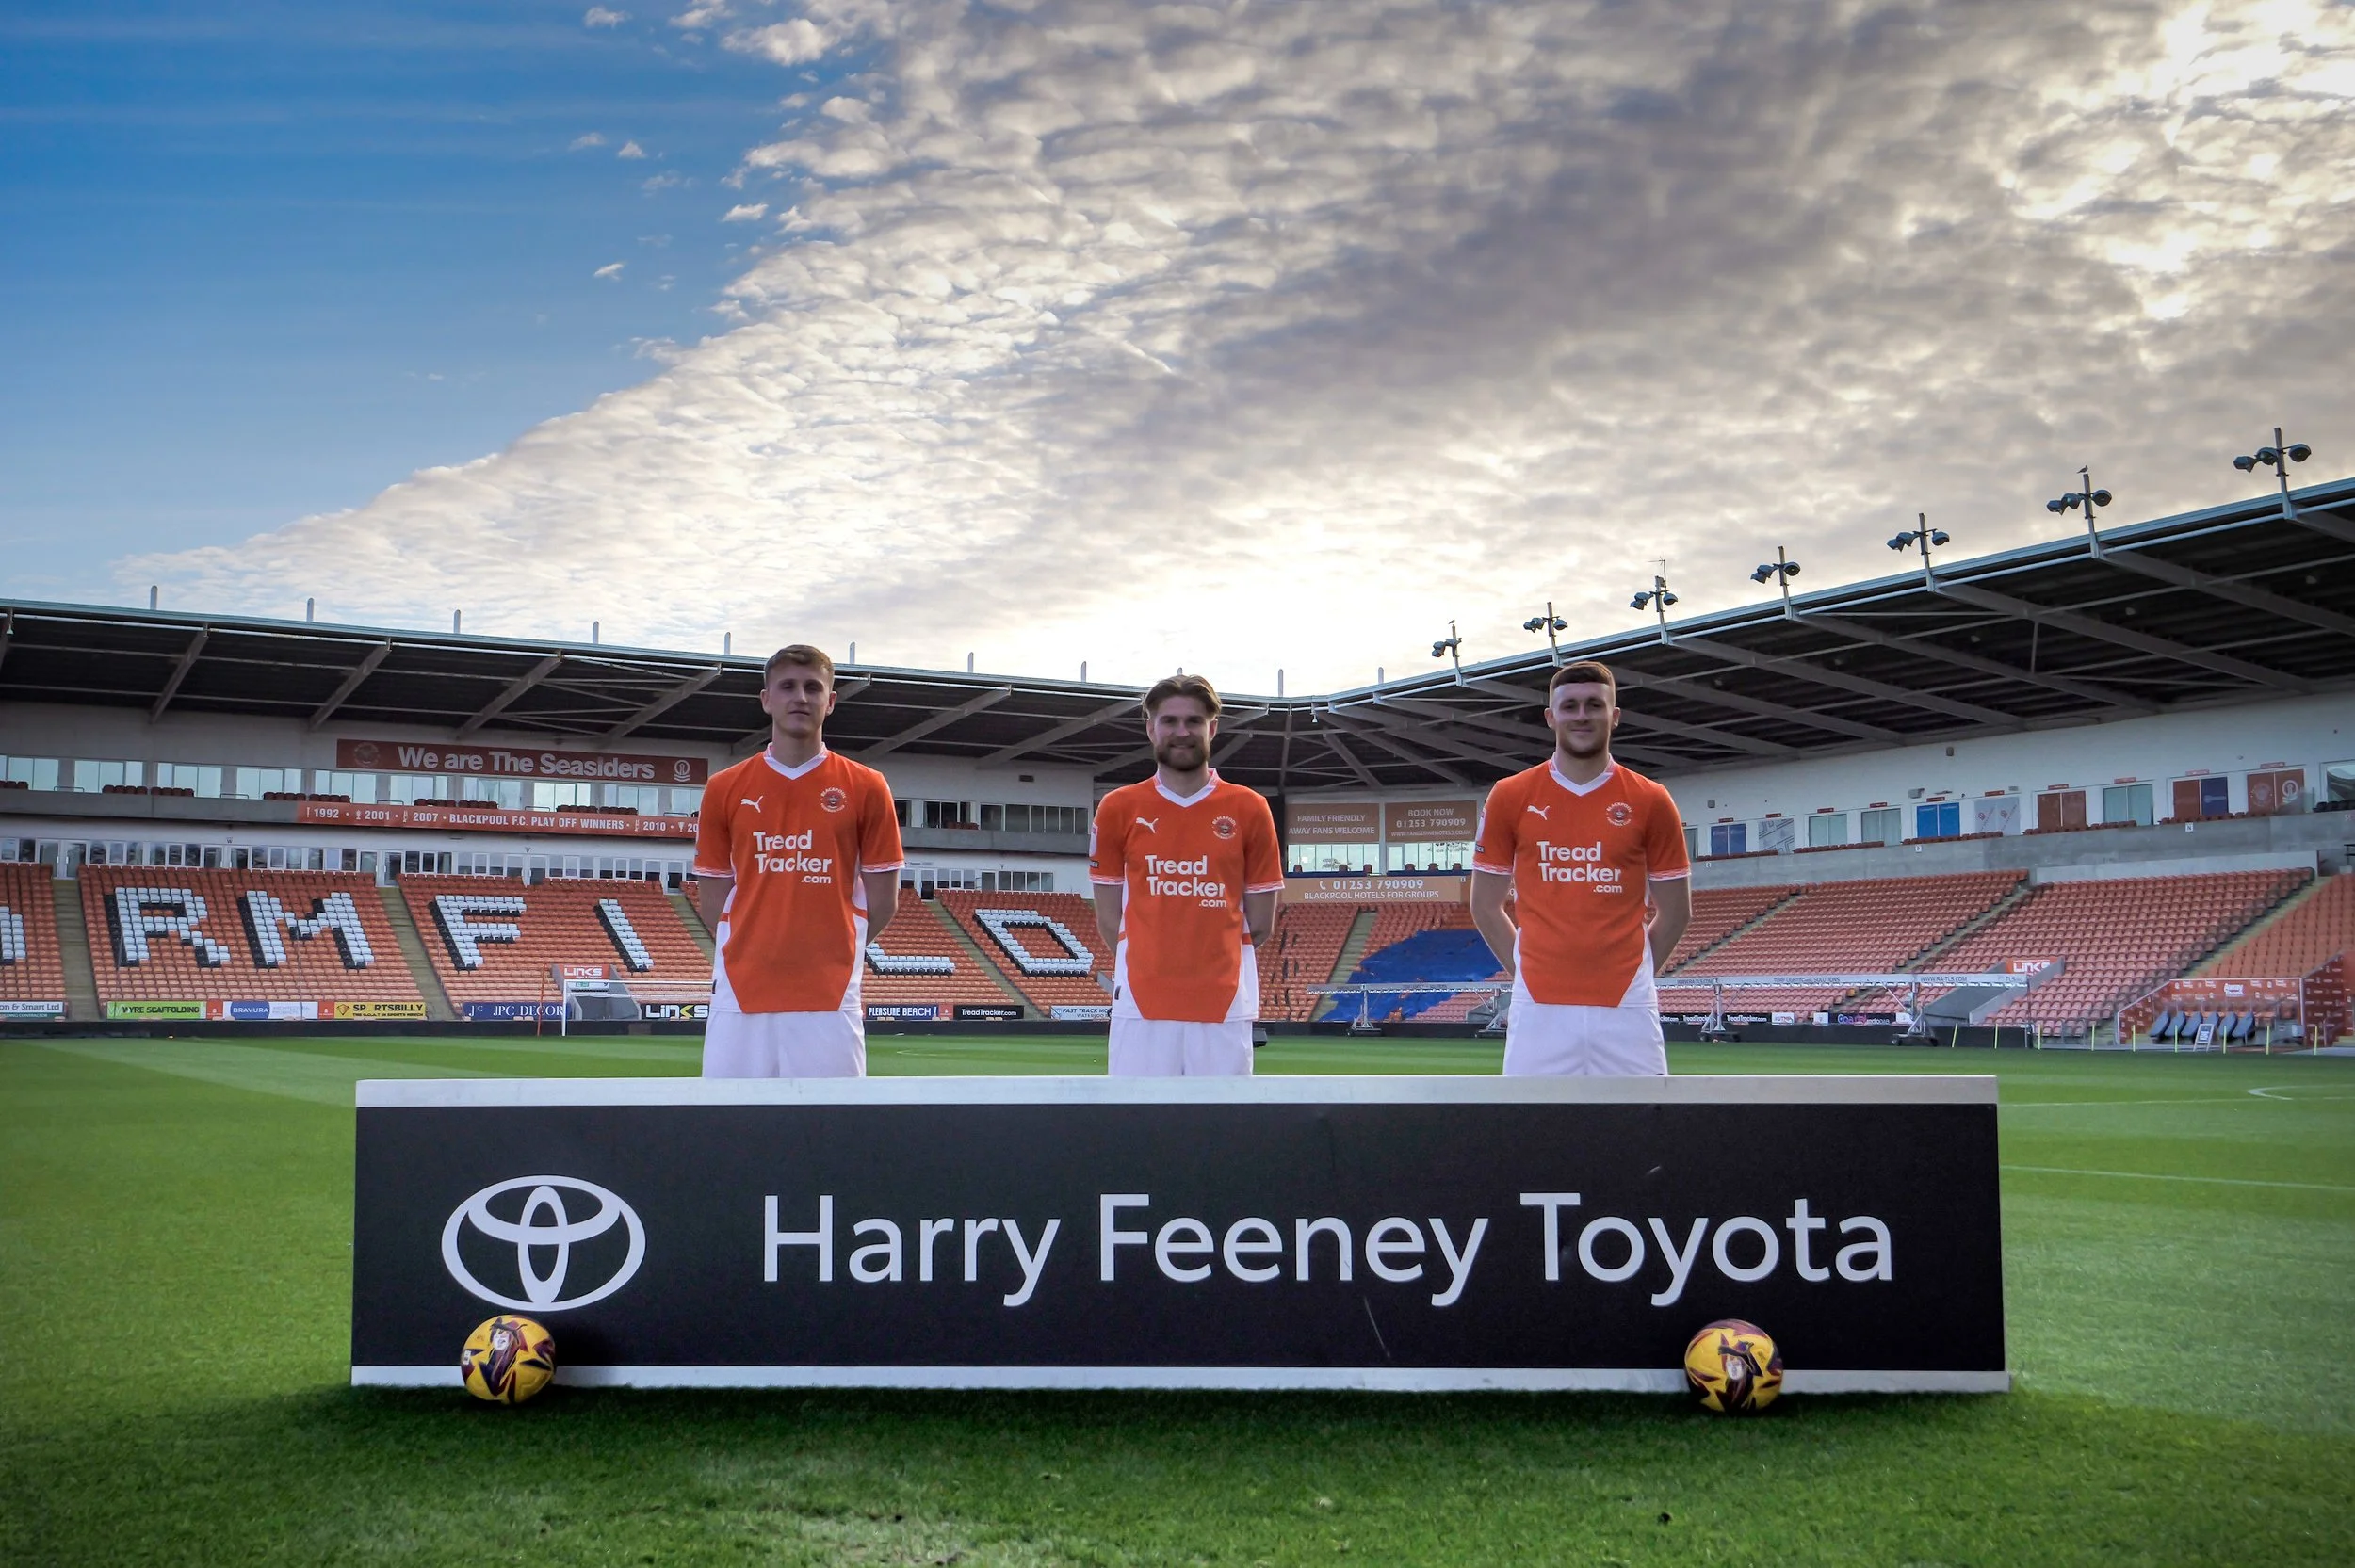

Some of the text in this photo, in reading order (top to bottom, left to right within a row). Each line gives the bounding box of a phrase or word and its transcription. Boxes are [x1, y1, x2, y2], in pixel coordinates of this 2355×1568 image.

[398, 745, 439, 769] We
[444, 753, 484, 771] are
[488, 751, 534, 773] The
[539, 753, 656, 780] Seasiders
[1433, 808, 1454, 816] NOW
[313, 807, 340, 818] 1992
[365, 810, 391, 821] 2001
[413, 812, 439, 823] 2007
[449, 813, 509, 826] BLACKPOOL
[512, 816, 528, 827] F.C.
[530, 816, 556, 828] PLAY
[558, 817, 577, 828] OFF
[579, 818, 625, 830] WINNERS
[642, 820, 667, 832] 2010
[1297, 814, 1366, 823] FAMILY FRIENDLY
[1396, 818, 1466, 828] 01253 790909
[1289, 826, 1375, 835] AWAY FANS WELCOME
[752, 829, 812, 852] Tread
[1536, 840, 1601, 862] Tread
[754, 851, 833, 874] Tracker
[1145, 854, 1207, 875] Tread
[1537, 862, 1622, 882] Tracker
[801, 875, 832, 884] .com
[1333, 879, 1424, 890] 01253 790909
[1146, 876, 1226, 897] Tracker
[1592, 884, 1623, 893] .com
[1304, 890, 1439, 900] BLACKPOOL HOTELS FOR GROUPS
[1198, 897, 1226, 908] .com
[493, 1005, 515, 1016] JPC
[869, 1007, 931, 1017] PLEASURE BEACH
[961, 1008, 1017, 1017] TreadTracker.com
[1727, 1014, 1767, 1023] TreadTracker.com
[764, 1191, 1893, 1308] Harry Feeney Toyota
